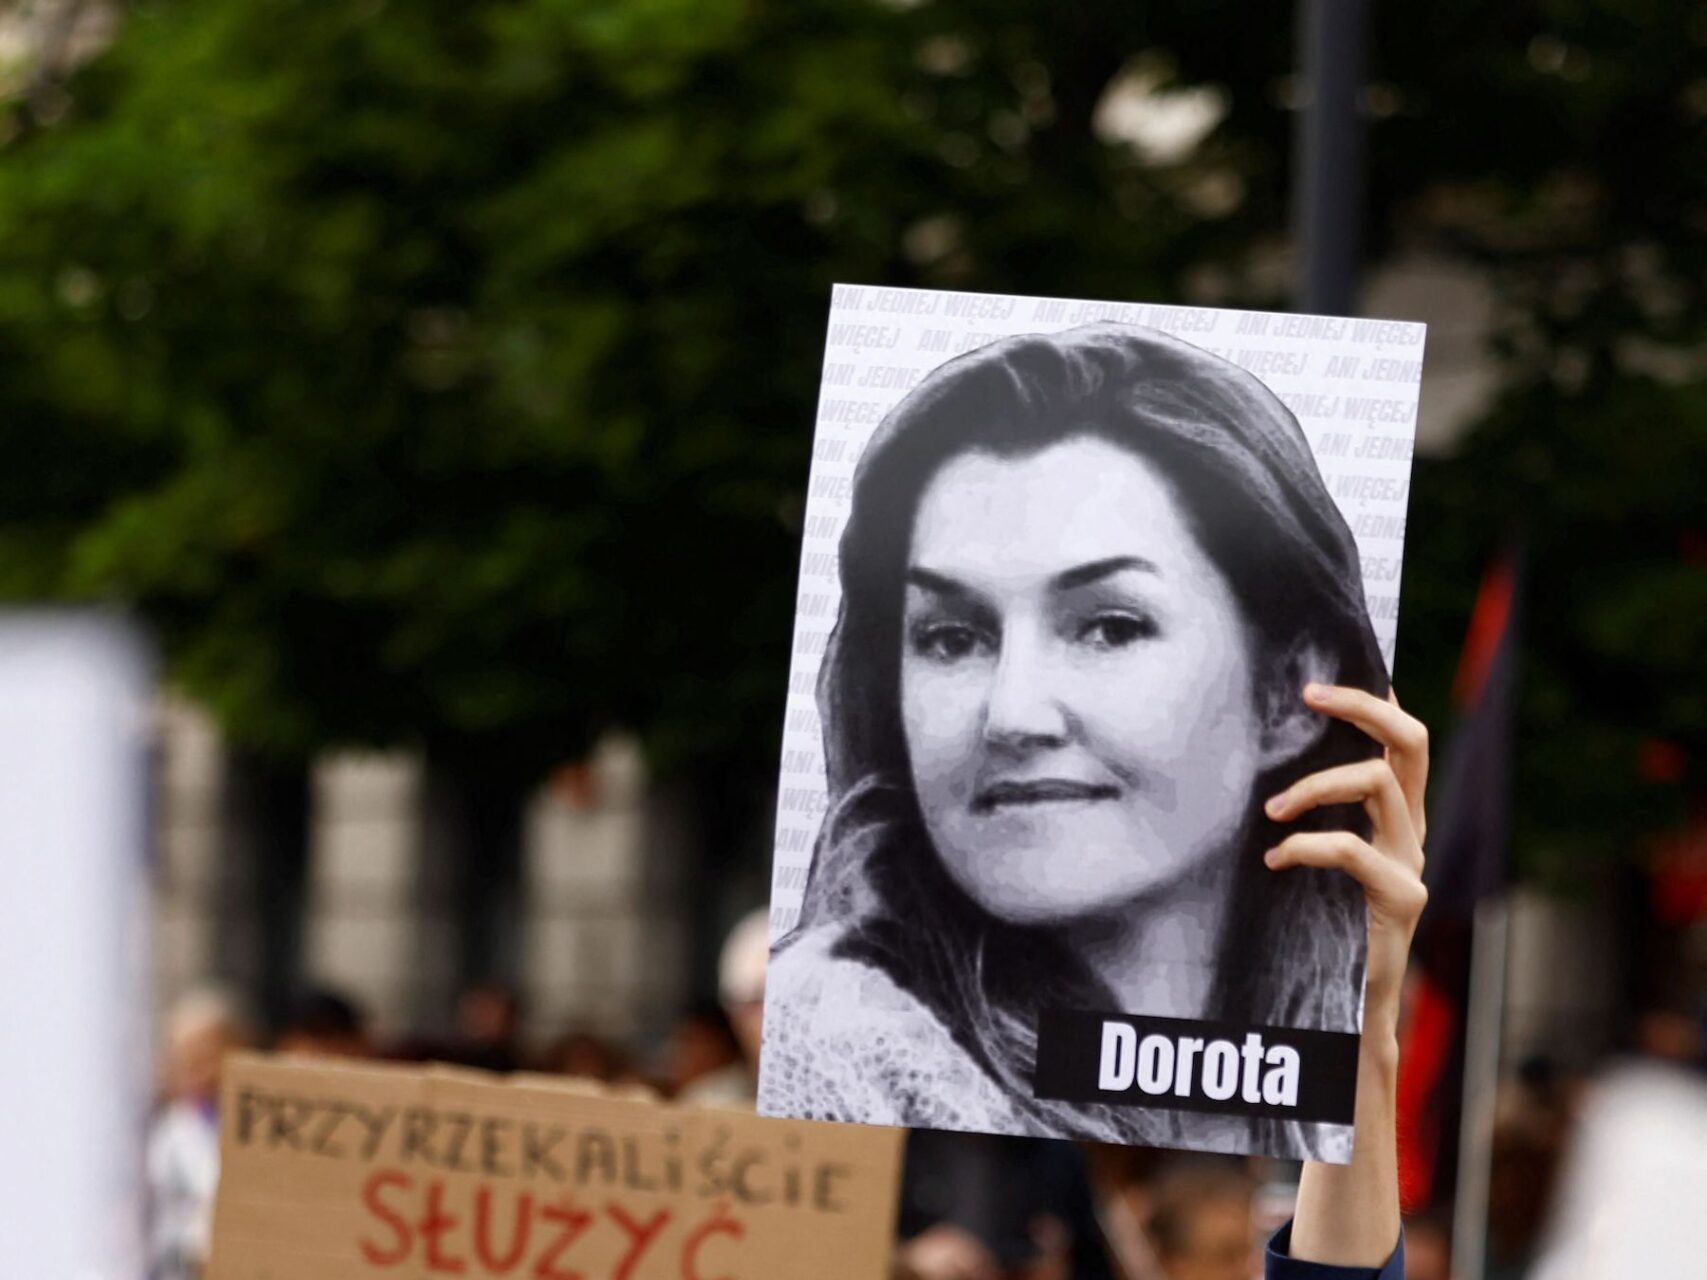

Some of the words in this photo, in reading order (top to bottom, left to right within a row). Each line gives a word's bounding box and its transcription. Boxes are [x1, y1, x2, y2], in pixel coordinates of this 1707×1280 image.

[866, 290, 941, 315] JEDNEJ
[943, 294, 1017, 326] WIĘCEJ
[1032, 300, 1068, 323] ANI
[1235, 312, 1271, 336] ANI
[1273, 315, 1348, 341] JEDNEJ
[1351, 320, 1425, 351] WIĘCEJ
[829, 323, 902, 354] WIĘCEJ
[916, 329, 953, 352] ANI
[1323, 355, 1361, 379] ANI
[1342, 396, 1417, 429] WIĘCEJ
[1315, 432, 1352, 457] ANI
[1334, 474, 1409, 507] WIĘCEJ
[1098, 1021, 1300, 1107] Dorota
